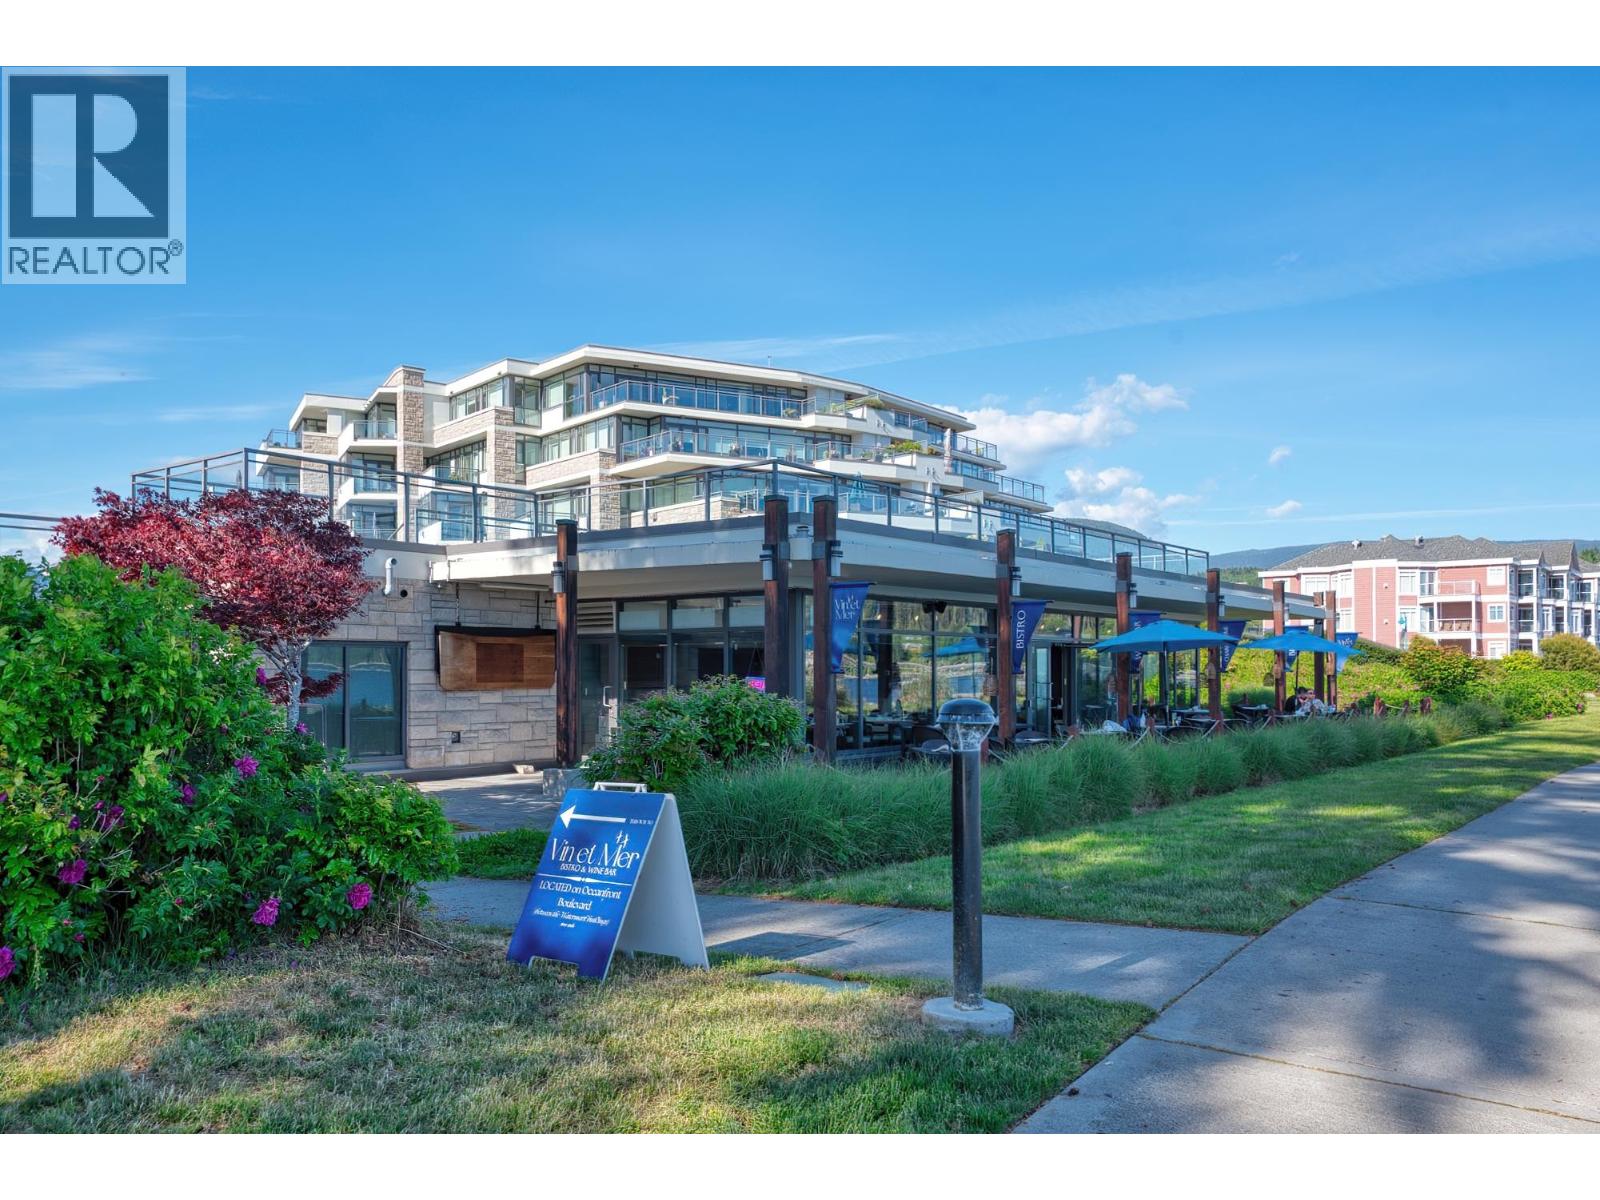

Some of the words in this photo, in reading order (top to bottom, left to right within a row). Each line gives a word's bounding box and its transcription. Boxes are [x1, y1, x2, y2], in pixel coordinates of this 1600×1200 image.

[1015, 609, 1027, 649] BISTRO
[551, 838, 575, 862] Vin
[577, 844, 596, 865] et
[598, 842, 640, 869] Mer
[539, 880, 572, 894] LOCATED
[571, 886, 581, 894] on
[557, 897, 593, 911] Boulevard
